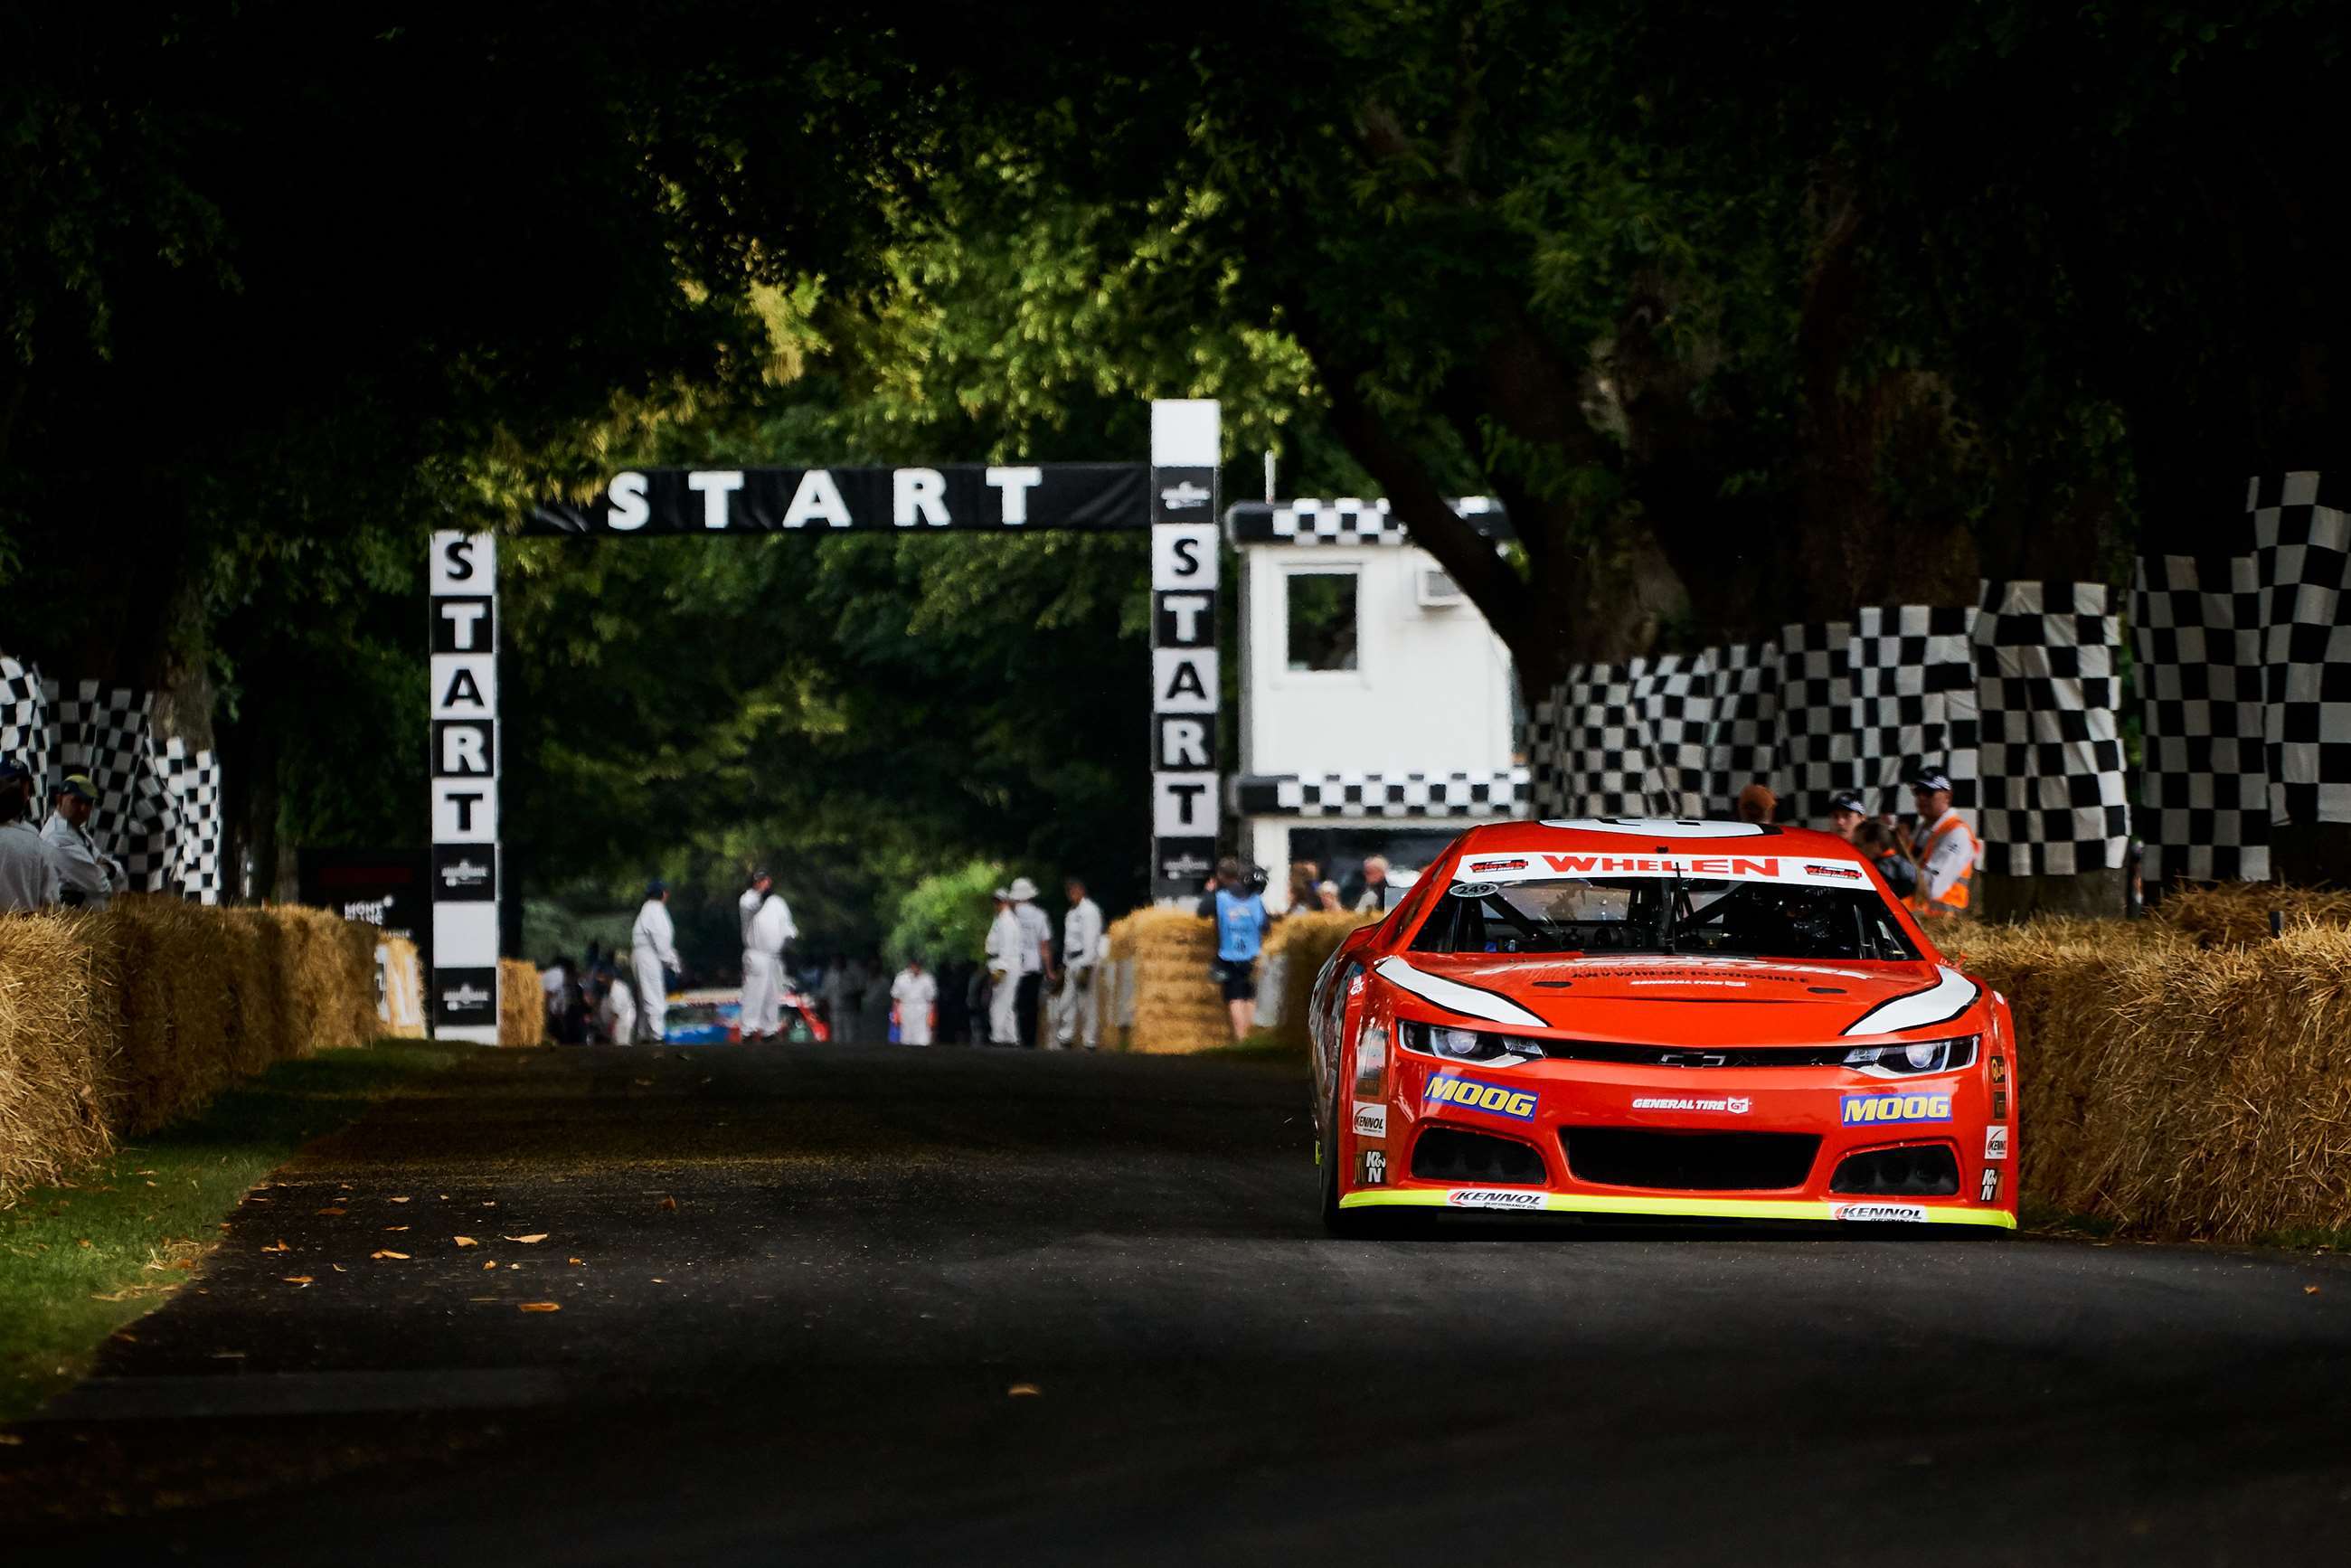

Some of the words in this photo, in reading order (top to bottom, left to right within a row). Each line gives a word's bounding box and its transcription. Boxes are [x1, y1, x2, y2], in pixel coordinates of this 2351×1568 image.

[608, 467, 1042, 530] START
[442, 542, 486, 833] START
[1162, 539, 1209, 824] START
[1542, 855, 1780, 877] WHELEN
[1459, 884, 1490, 894] 249
[1425, 1076, 1537, 1118] MOOG
[1632, 1099, 1694, 1110] GENERAL
[1695, 1100, 1726, 1110] TIRE
[1844, 1095, 1950, 1122] MOOG
[1356, 1114, 1384, 1129] KENNOL
[1456, 1191, 1542, 1205] KENNOL
[1842, 1207, 1922, 1220] KENNOL
